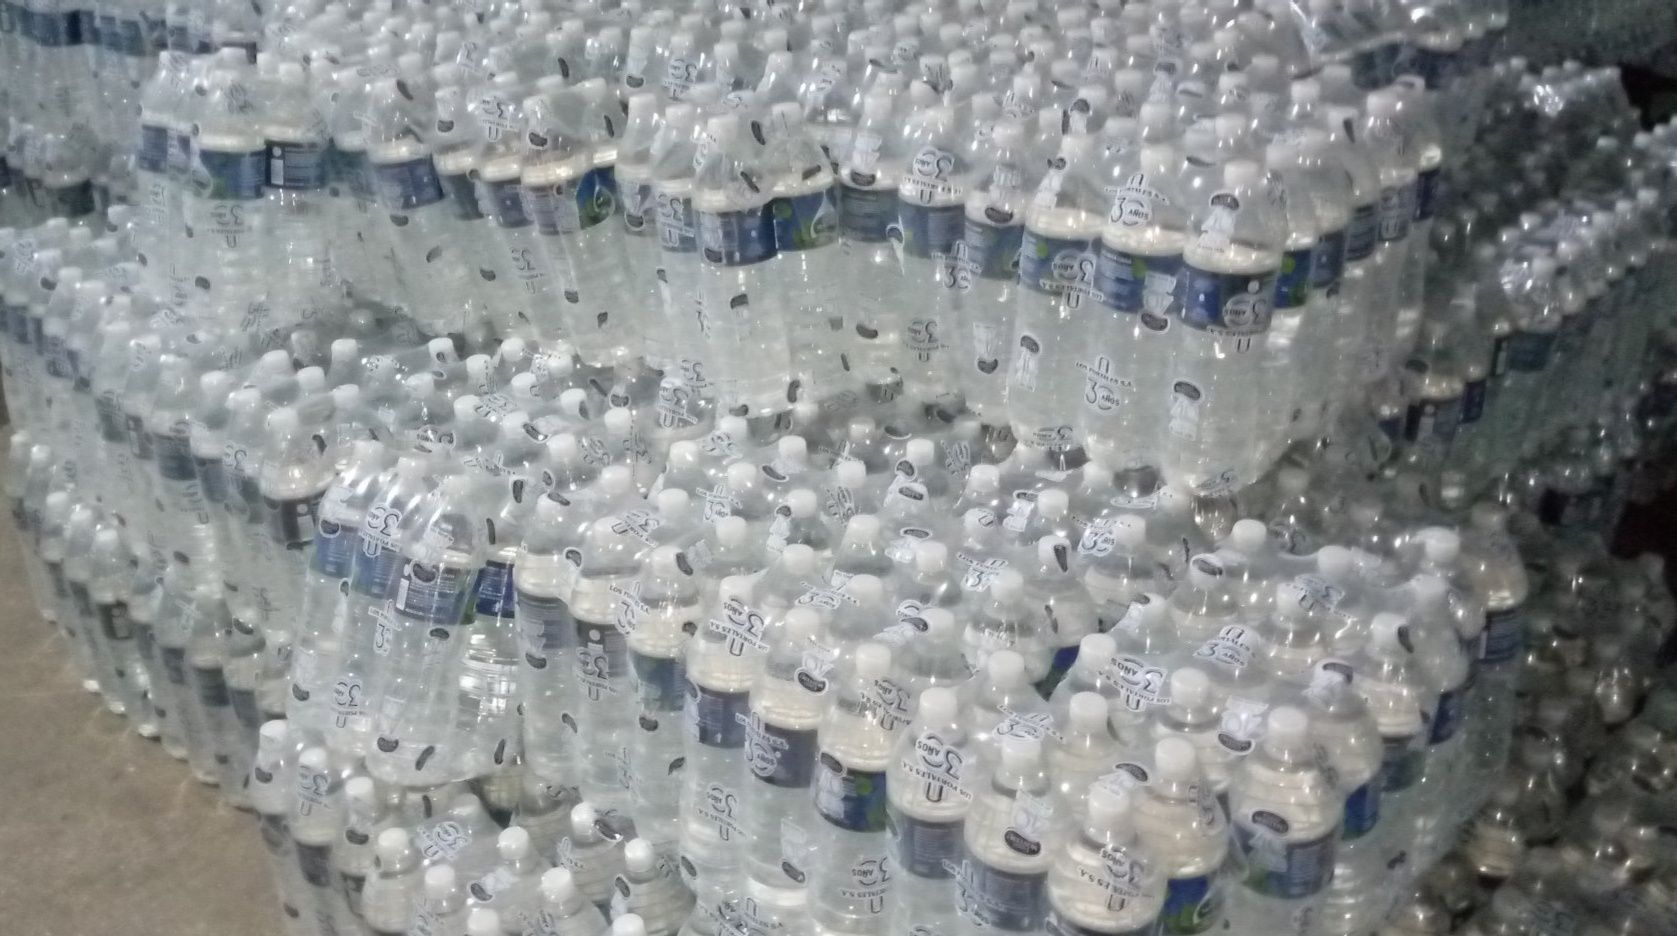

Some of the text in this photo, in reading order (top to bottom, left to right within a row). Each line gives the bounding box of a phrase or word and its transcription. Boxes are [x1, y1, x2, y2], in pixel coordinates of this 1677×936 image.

[1128, 209, 1149, 220] AÑOS
[723, 602, 743, 617] AÑOS
[1110, 657, 1139, 676] AÑOS
[916, 741, 941, 757] AÑOS
[915, 767, 959, 792] PORTALES
[852, 868, 875, 879] AÑOS
